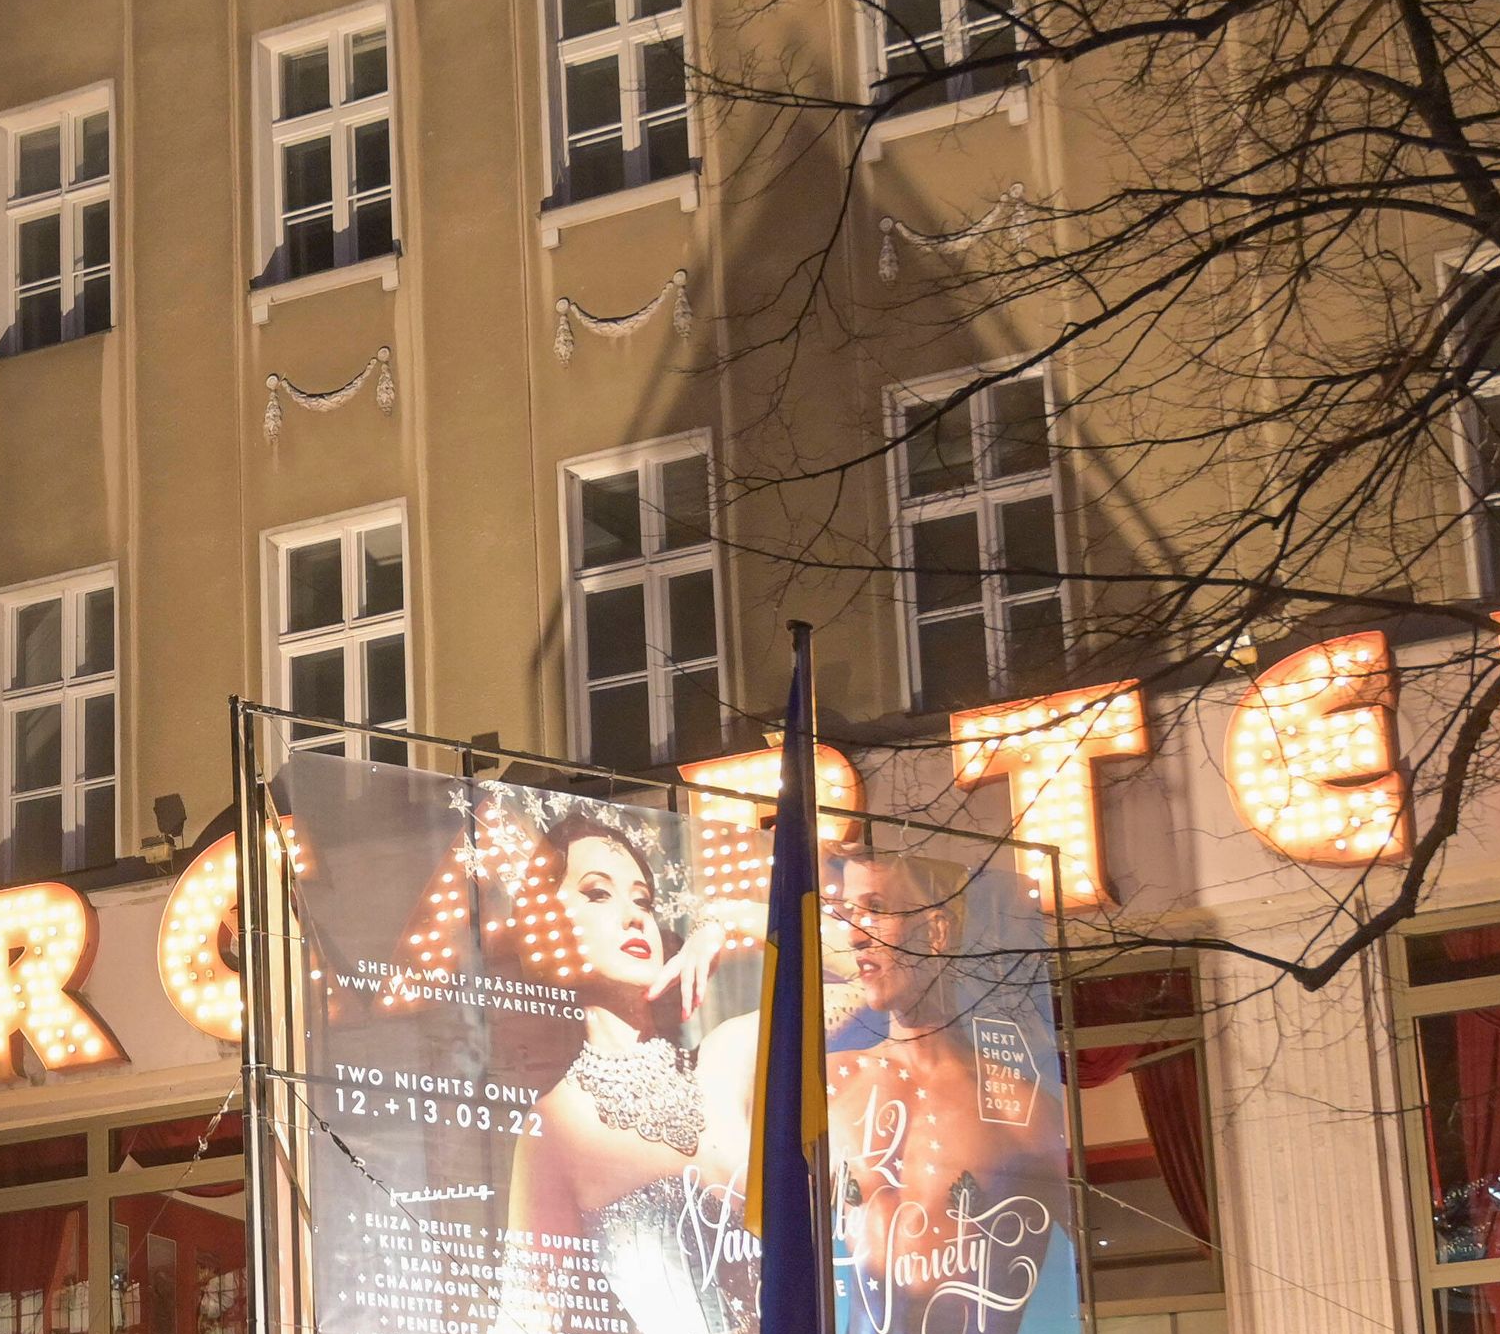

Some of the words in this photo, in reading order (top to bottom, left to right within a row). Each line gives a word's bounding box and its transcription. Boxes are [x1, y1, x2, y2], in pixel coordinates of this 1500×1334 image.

[358, 960, 414, 979] SHEILA
[424, 970, 467, 987] WOLF
[475, 976, 577, 1003] PRÄSENTIERT
[981, 1031, 1016, 1046] NEXT
[983, 1048, 1025, 1063] SHOW
[985, 1064, 1026, 1081] 17./18.
[336, 1064, 384, 1085] TWO
[396, 1071, 475, 1098] NIGHTS
[485, 1083, 539, 1105] ONLY
[985, 1080, 1016, 1095] SEPT
[335, 1089, 543, 1137] 12.+13.03.22
[985, 1097, 1021, 1113] 2022
[390, 1184, 495, 1207] featuring
[366, 1213, 411, 1231] ELIZA
[419, 1220, 472, 1238] DELITE
[496, 1228, 534, 1245] JAKE
[541, 1233, 600, 1253] DUPREE
[380, 1235, 413, 1251] KIKI
[421, 1240, 485, 1259] DEVILLE
[401, 1257, 442, 1275] BEAU
[374, 1274, 480, 1298] CHAMPAGNE
[488, 1286, 610, 1313] MOISELLE
[356, 1291, 443, 1314] HENRIETTE
[571, 1314, 629, 1334] MALTER
